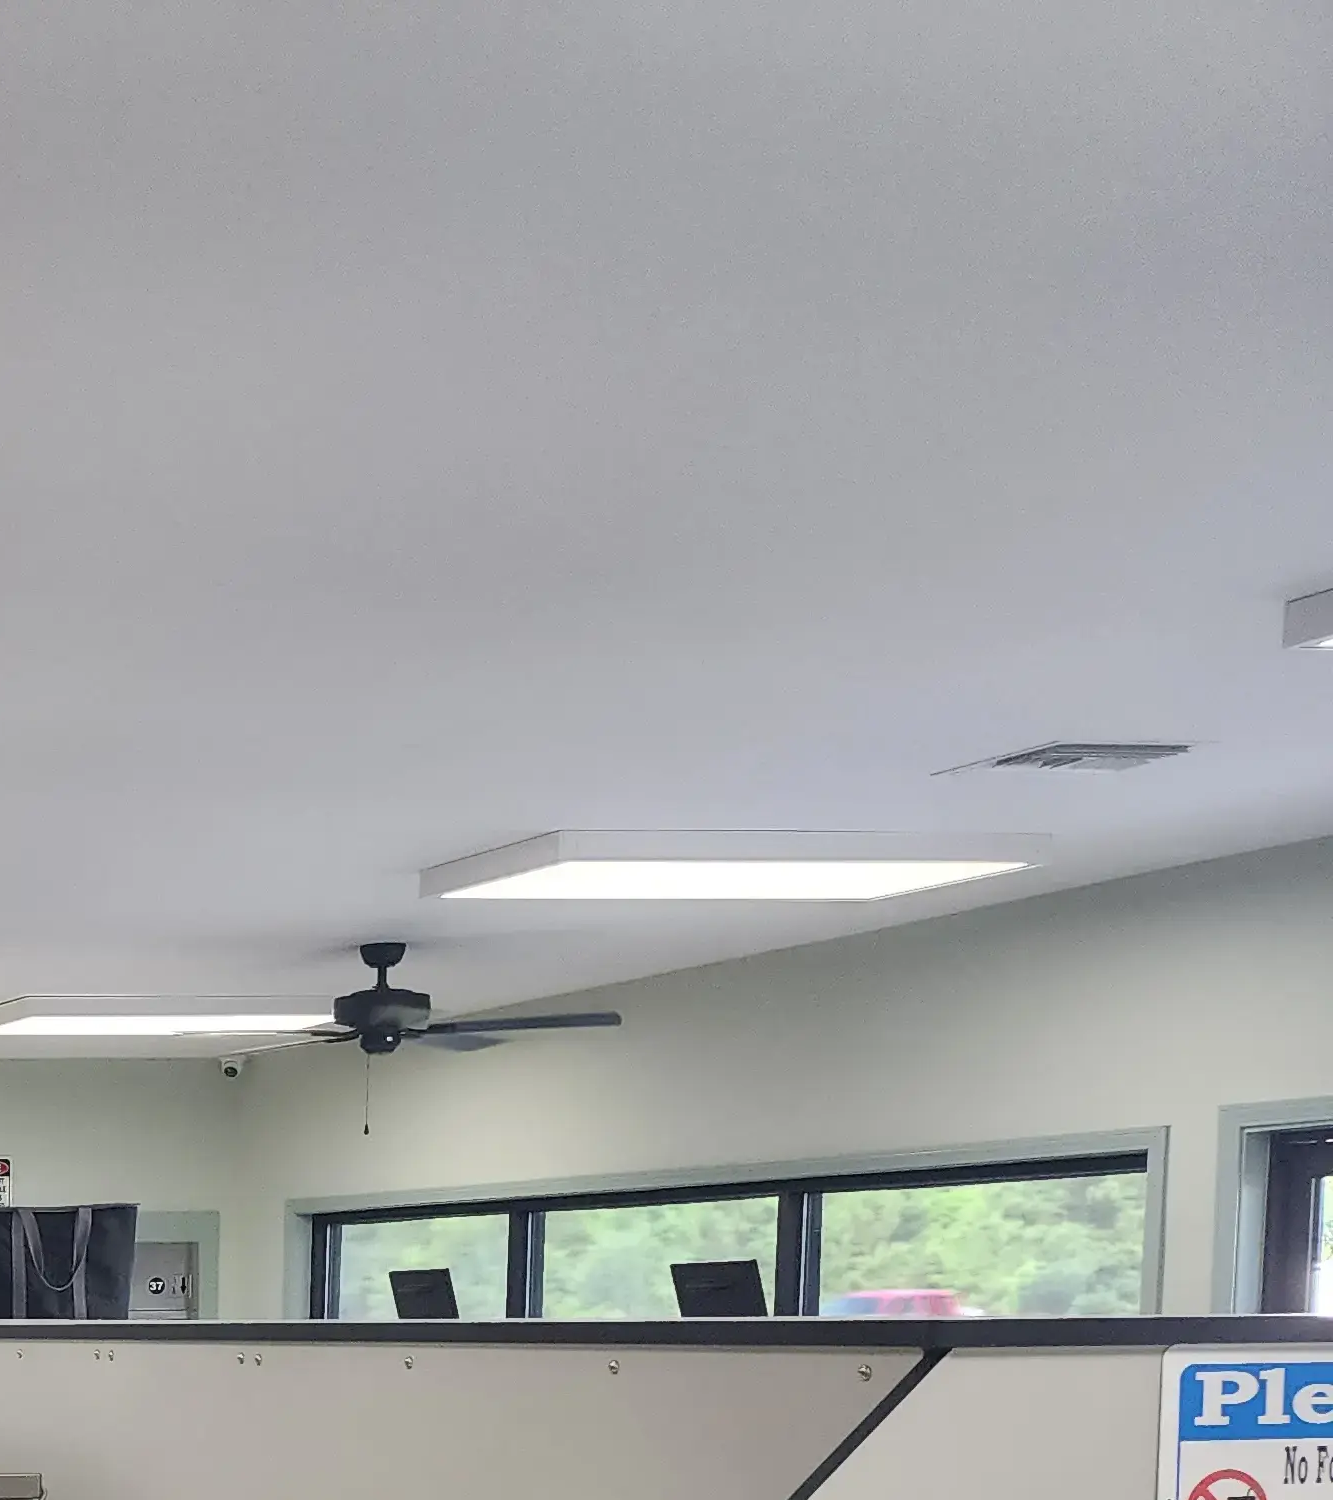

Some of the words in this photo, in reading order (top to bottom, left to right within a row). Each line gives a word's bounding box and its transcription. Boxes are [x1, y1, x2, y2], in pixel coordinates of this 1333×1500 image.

[149, 1281, 164, 1291] 37
[1194, 1367, 1333, 1427] Ple
[1283, 1445, 1309, 1485] No
